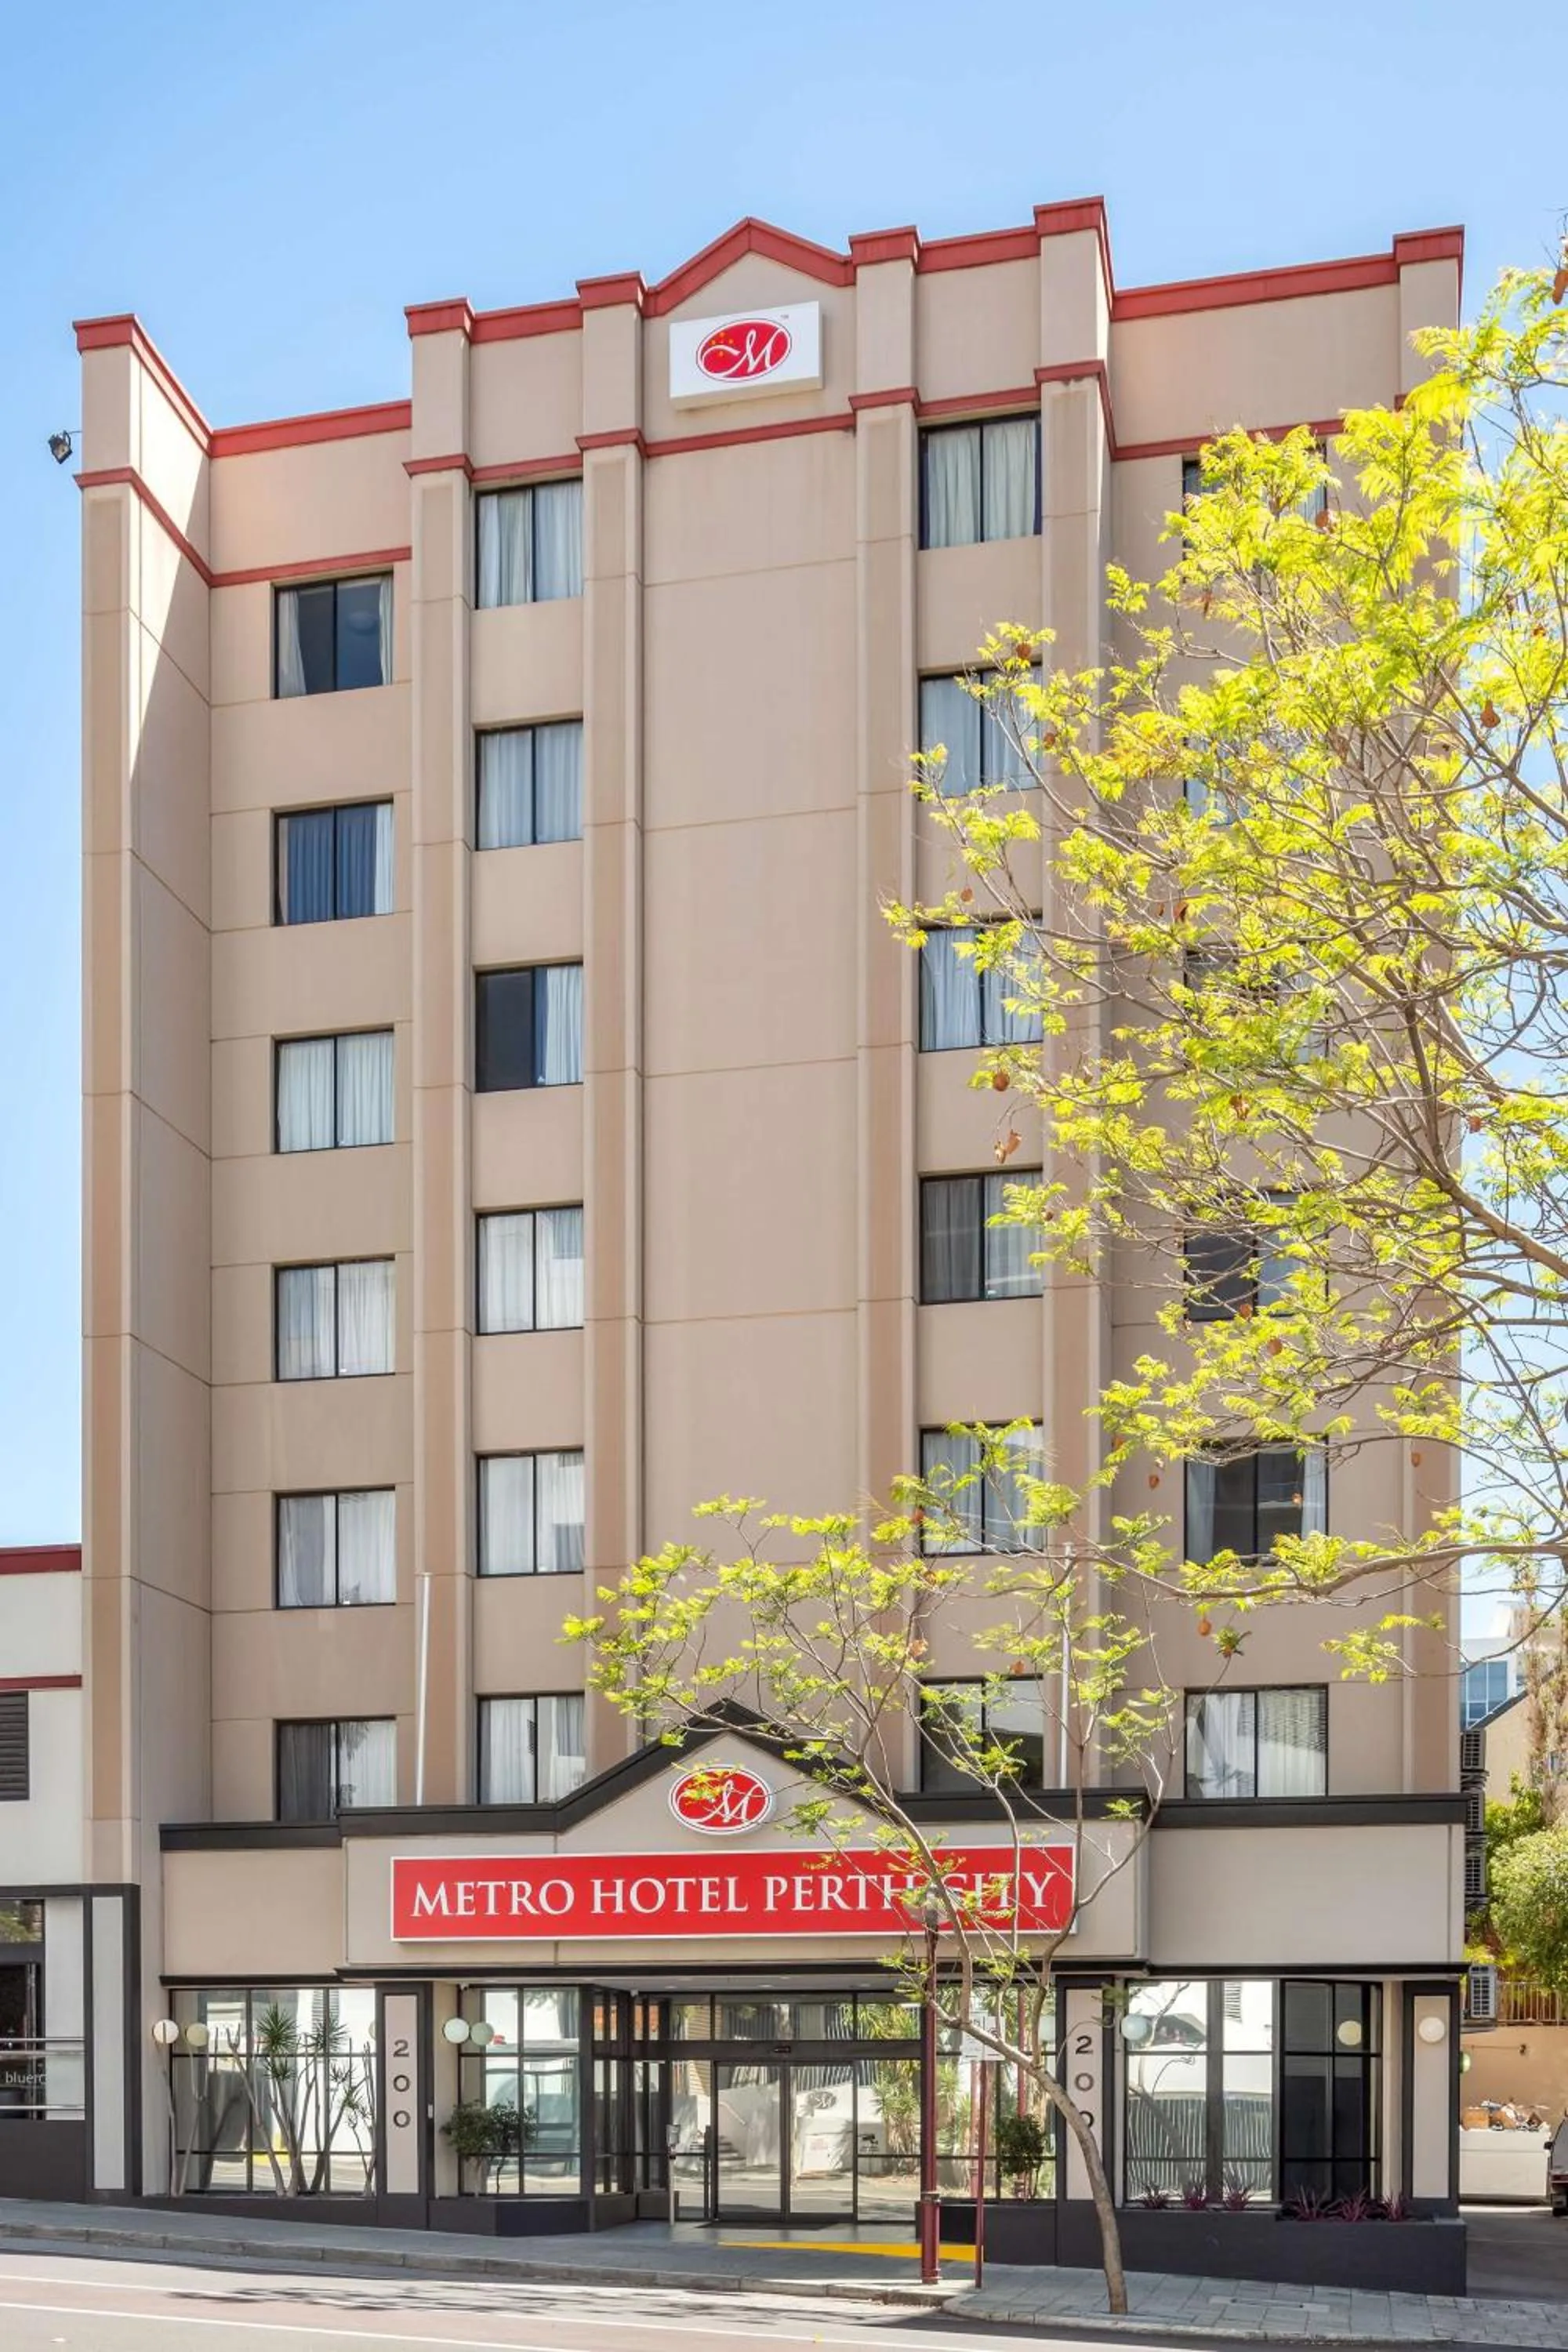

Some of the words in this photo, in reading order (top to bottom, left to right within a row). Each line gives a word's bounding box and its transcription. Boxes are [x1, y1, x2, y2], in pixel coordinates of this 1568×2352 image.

[410, 1879, 575, 1918] METRO
[590, 1876, 750, 1915] HOTEL
[764, 1873, 916, 1912] PERTH
[393, 2039, 411, 2129] 200
